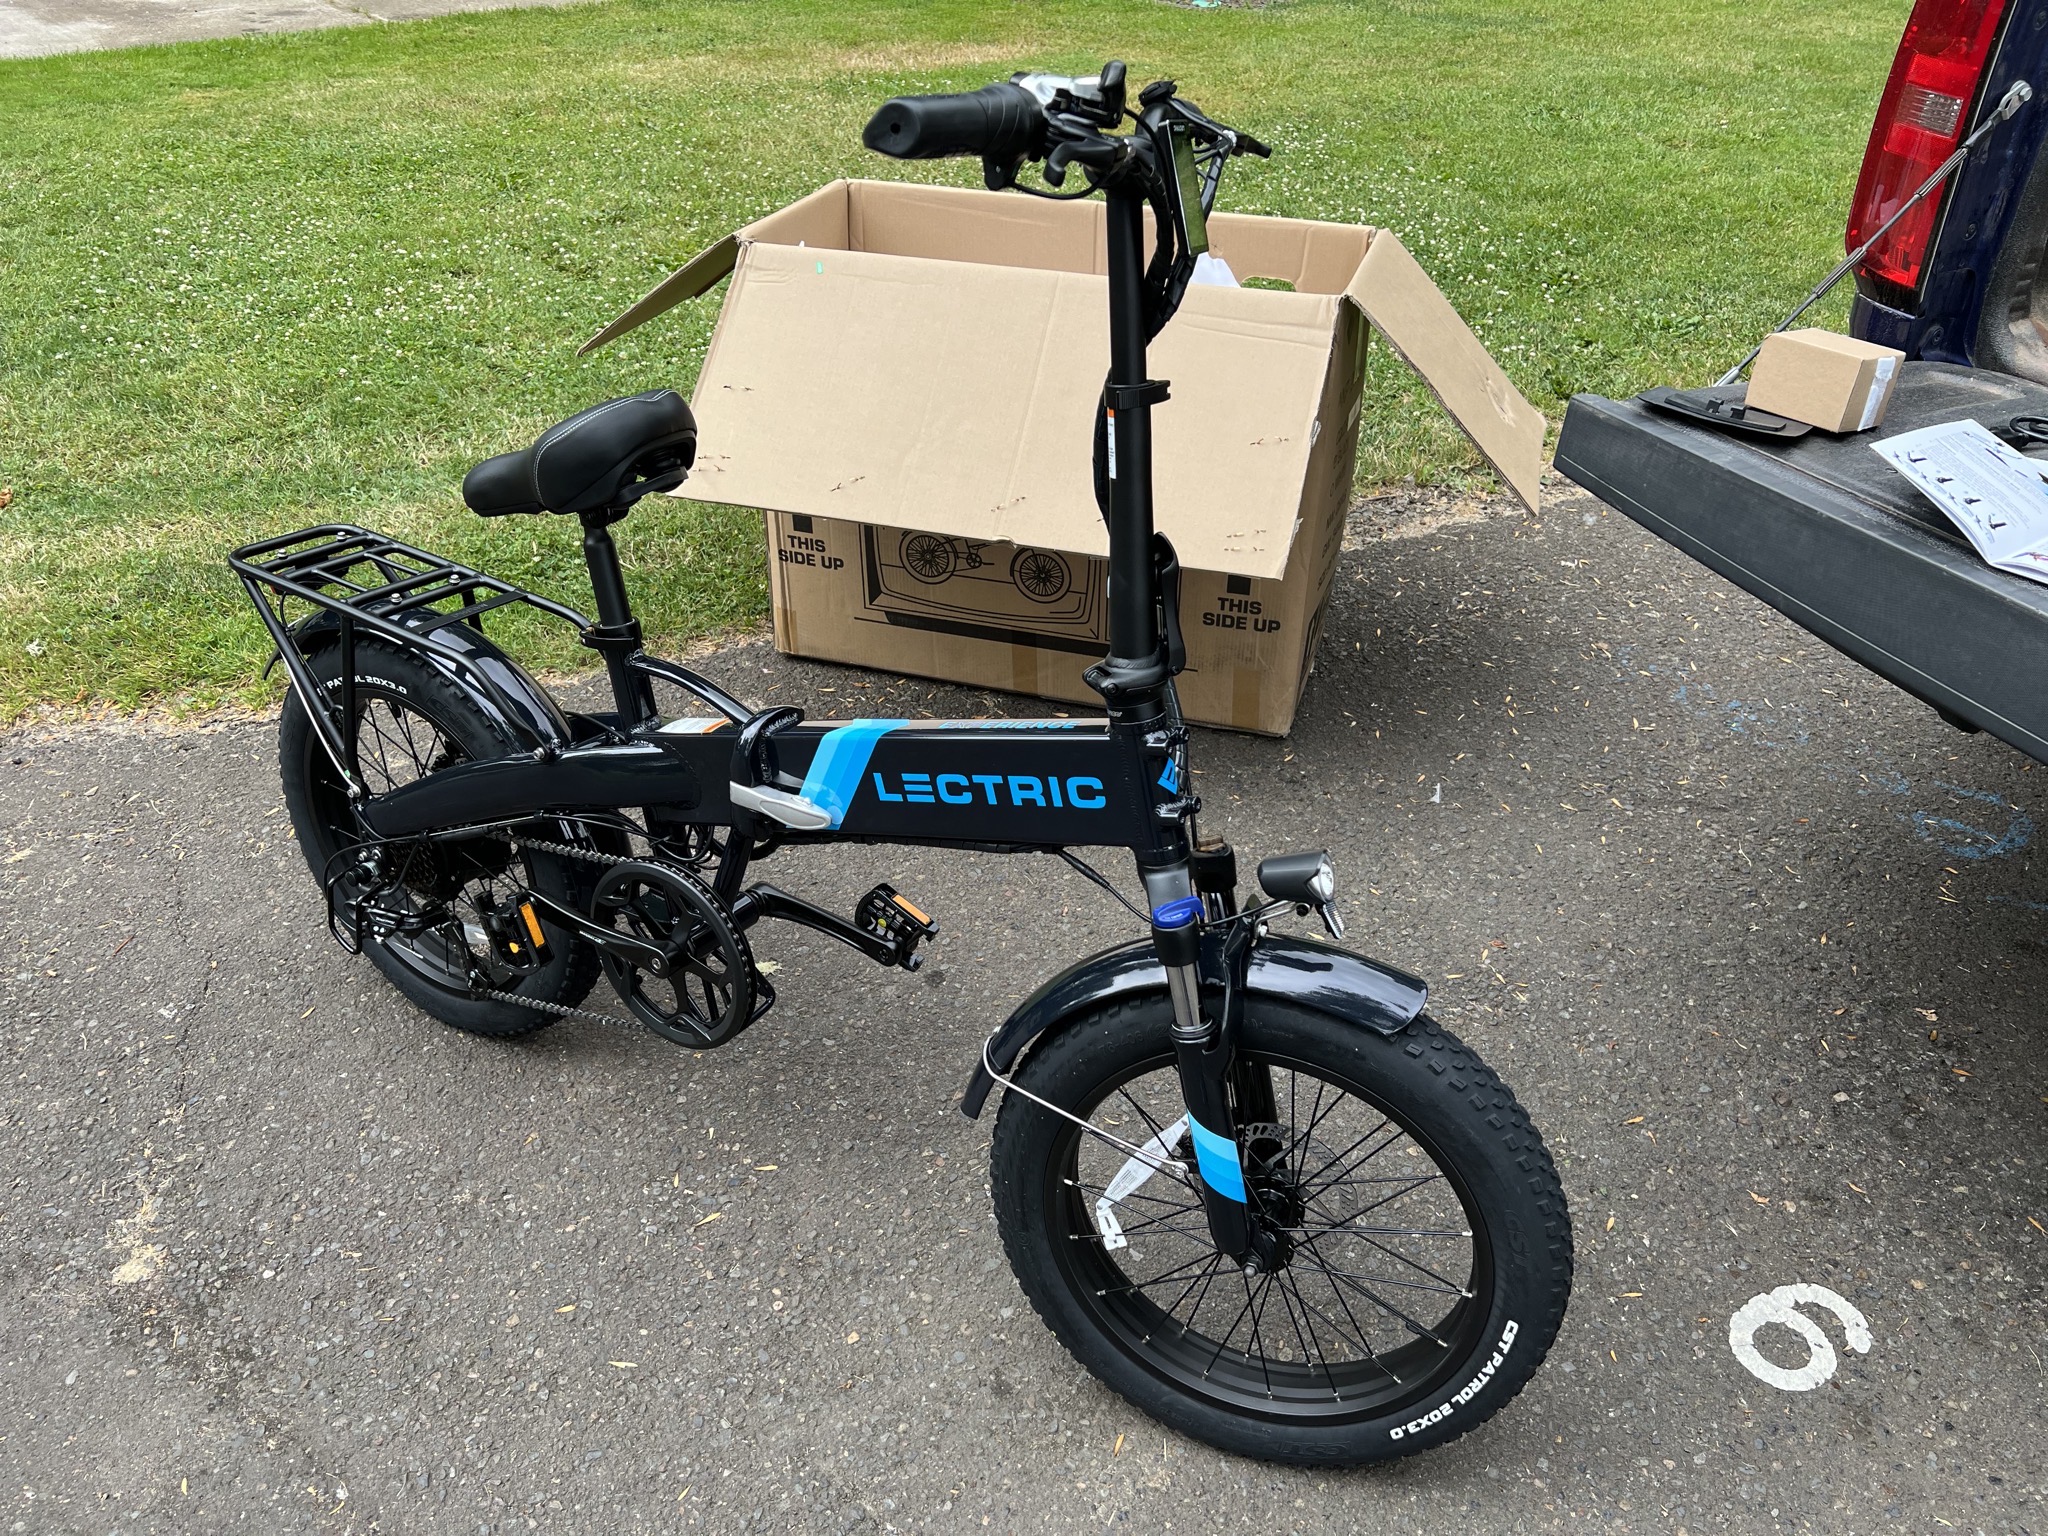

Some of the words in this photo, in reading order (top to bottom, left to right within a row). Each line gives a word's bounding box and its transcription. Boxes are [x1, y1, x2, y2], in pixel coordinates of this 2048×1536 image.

[787, 534, 826, 553] THIS
[778, 548, 816, 567] SIDE
[821, 555, 844, 570] UP
[1217, 597, 1262, 615] THIS
[1202, 612, 1247, 630] SIDE
[1253, 618, 1281, 633] UP
[939, 721, 1082, 729] EXPERIENCE
[873, 772, 1107, 809] LECTRIC
[1498, 1319, 1519, 1355] CST
[1451, 1351, 1504, 1405] PATROL
[1389, 1402, 1454, 1440] 20X3.0
